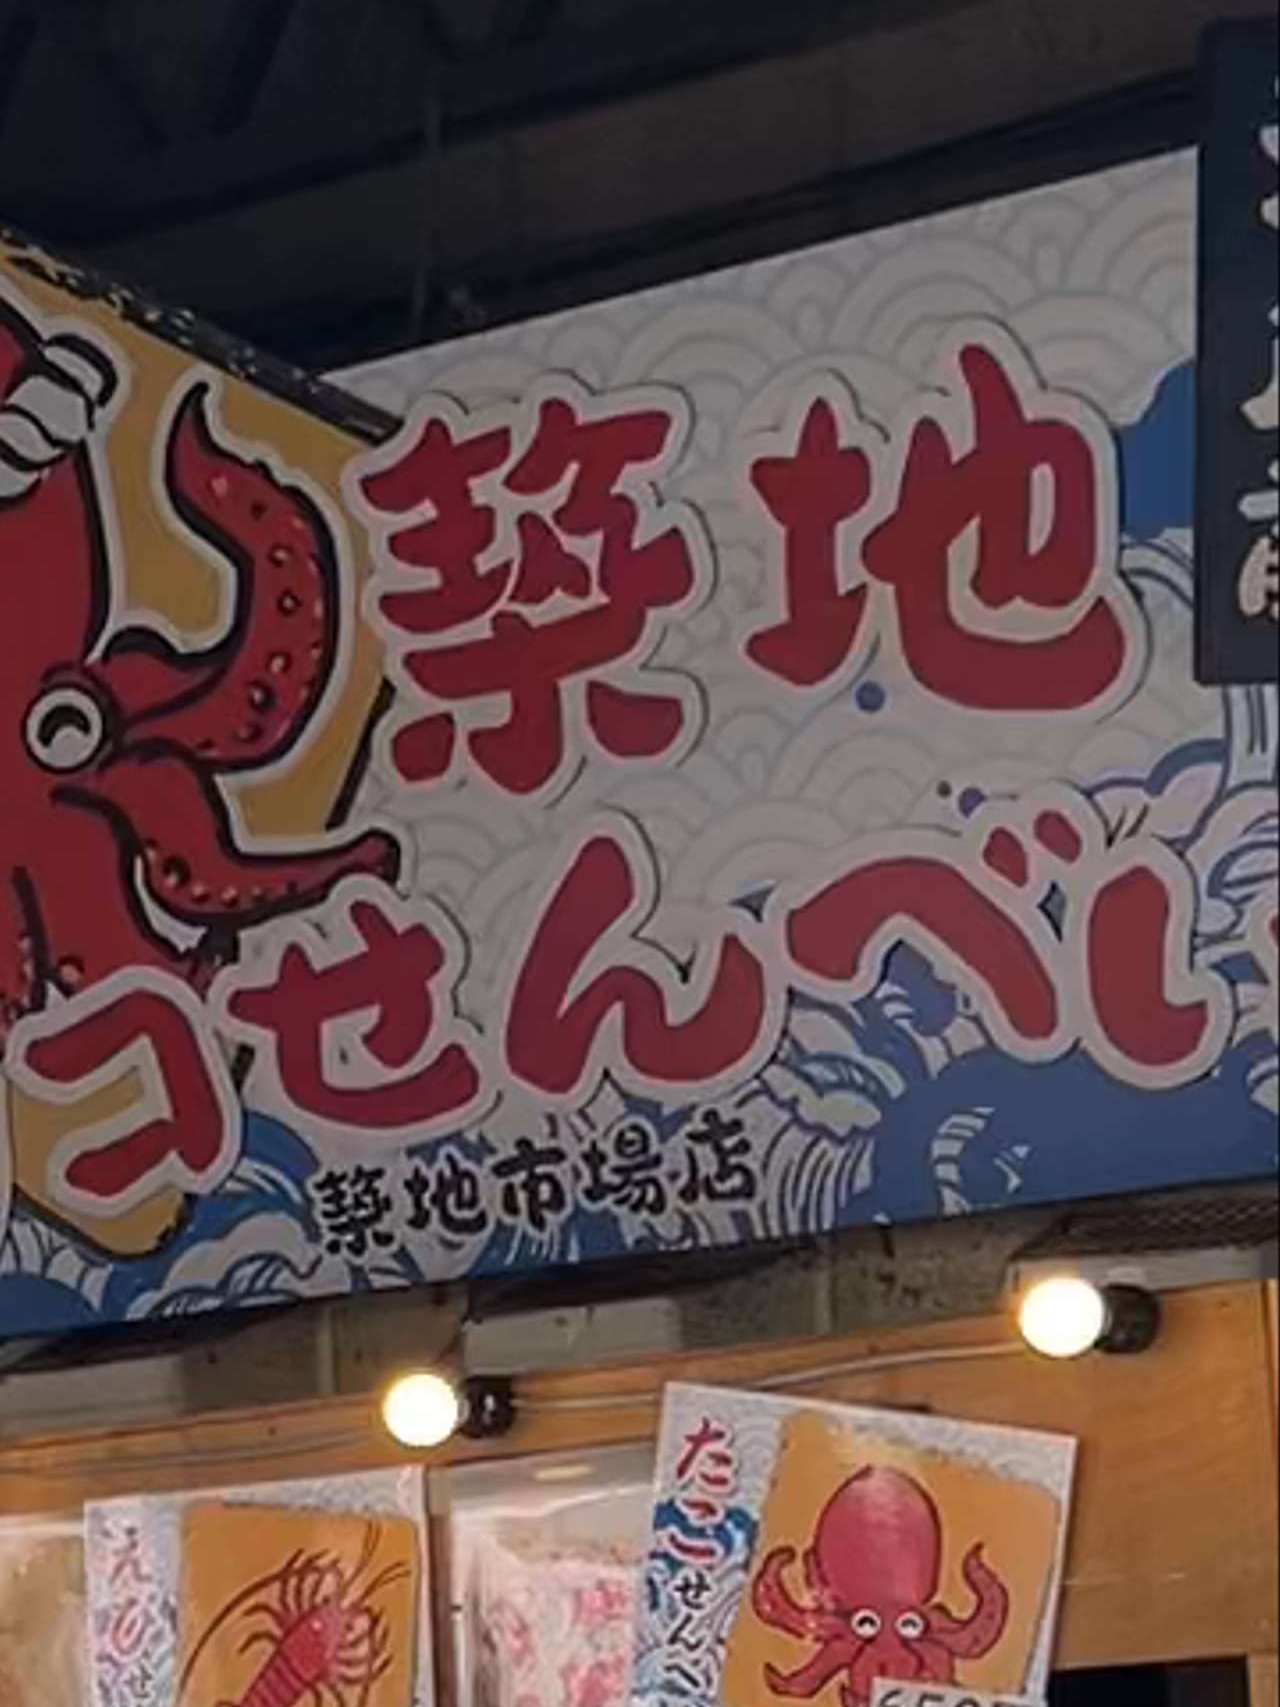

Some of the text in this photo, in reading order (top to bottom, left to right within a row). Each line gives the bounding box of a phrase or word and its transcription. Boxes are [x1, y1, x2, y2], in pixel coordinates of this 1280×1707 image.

[360, 344, 1128, 795] 築地
[312, 1108, 758, 1255] 築地市場店
